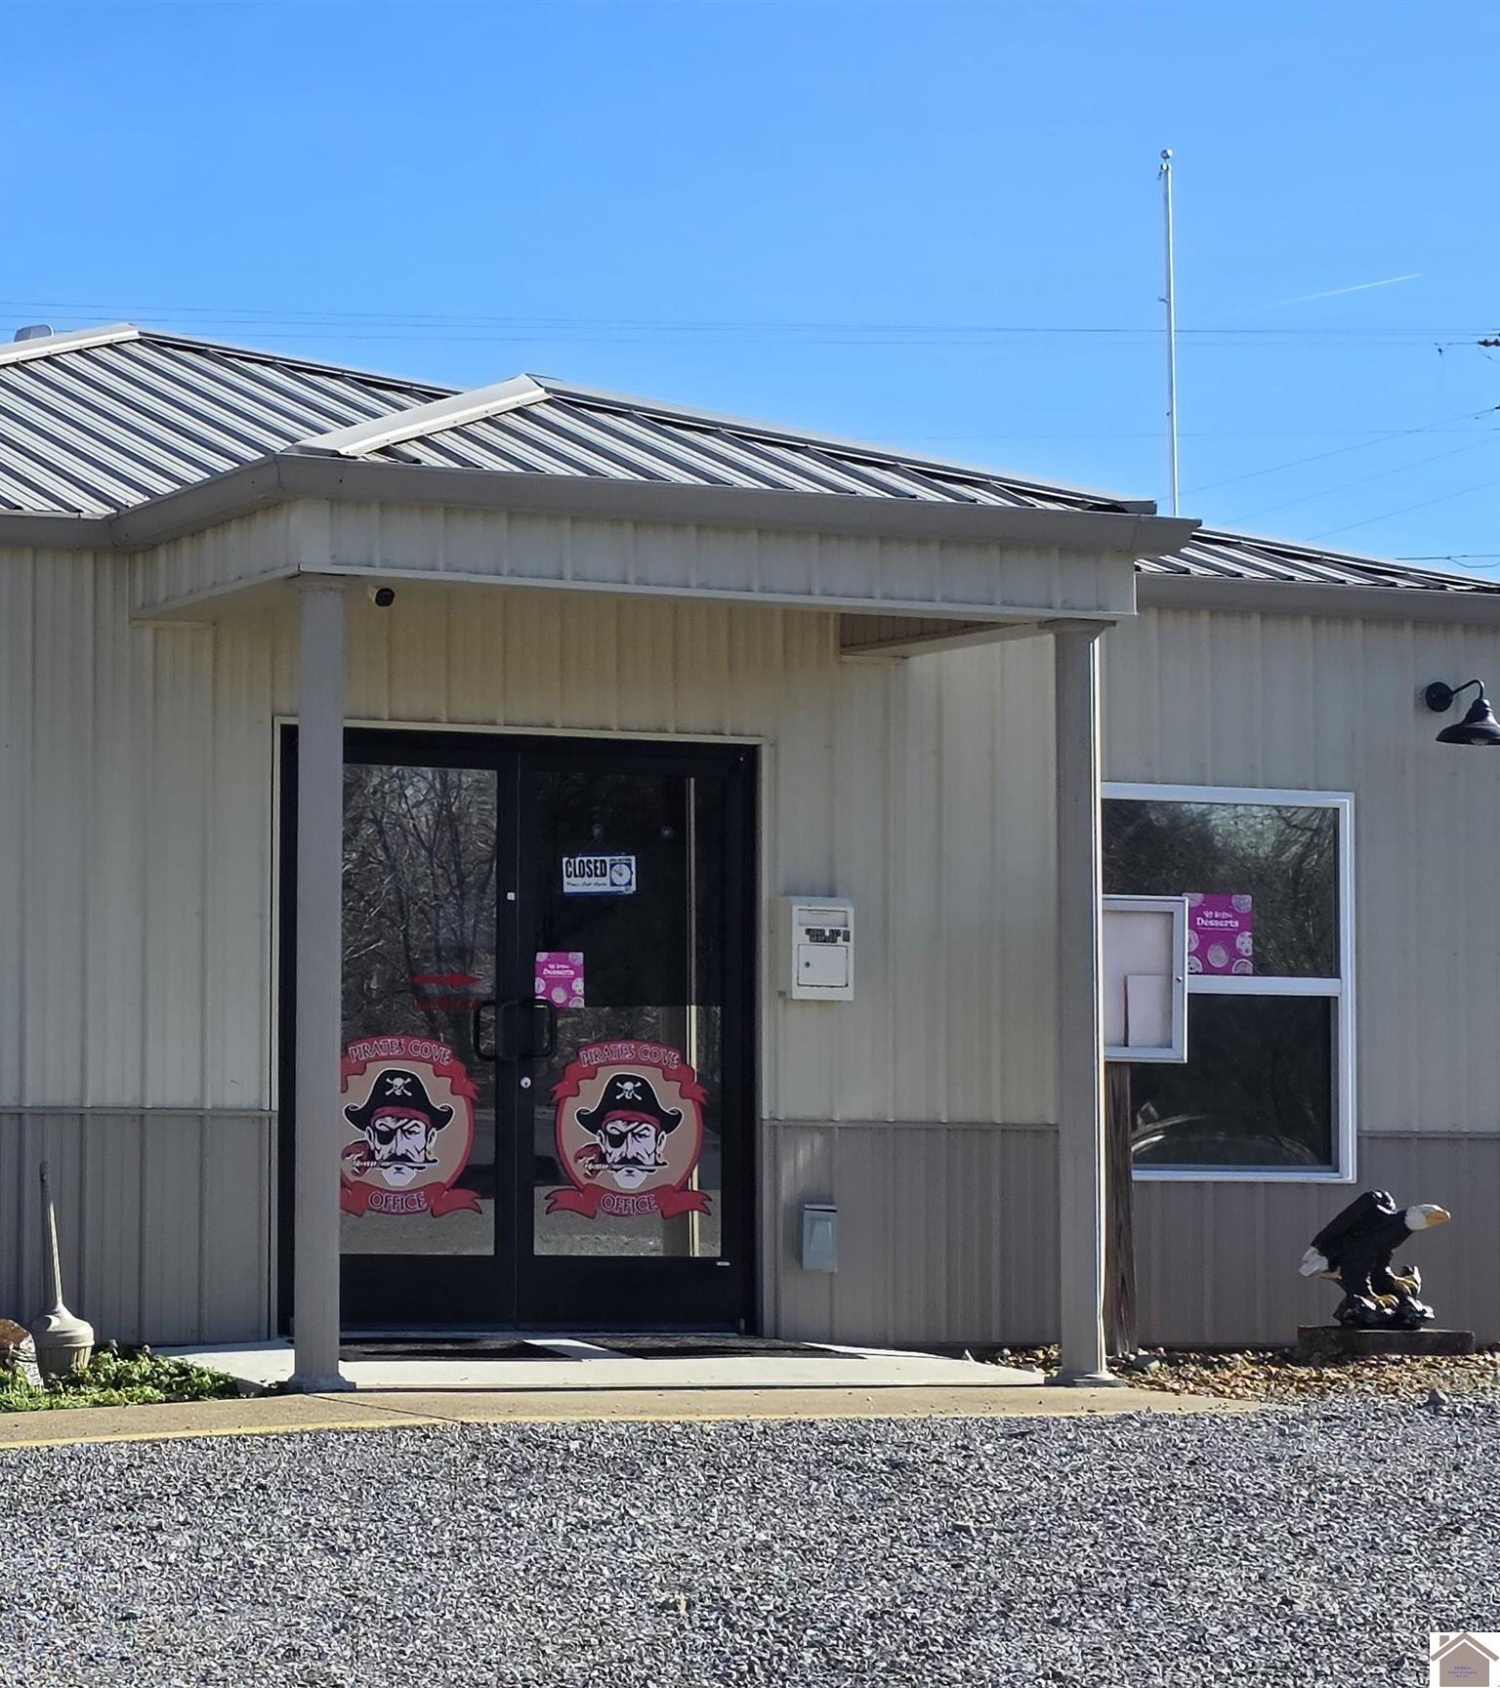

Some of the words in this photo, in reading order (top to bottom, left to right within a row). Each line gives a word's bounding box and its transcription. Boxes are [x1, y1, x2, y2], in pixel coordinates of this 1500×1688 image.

[565, 859, 607, 878] CLOSED
[348, 1038, 406, 1063] PIRATES
[408, 1039, 454, 1066] COVE
[580, 1043, 636, 1068] PIRATES
[638, 1044, 680, 1070] COVE
[368, 1190, 428, 1212] OFFICE
[600, 1193, 658, 1215] OFFICE
